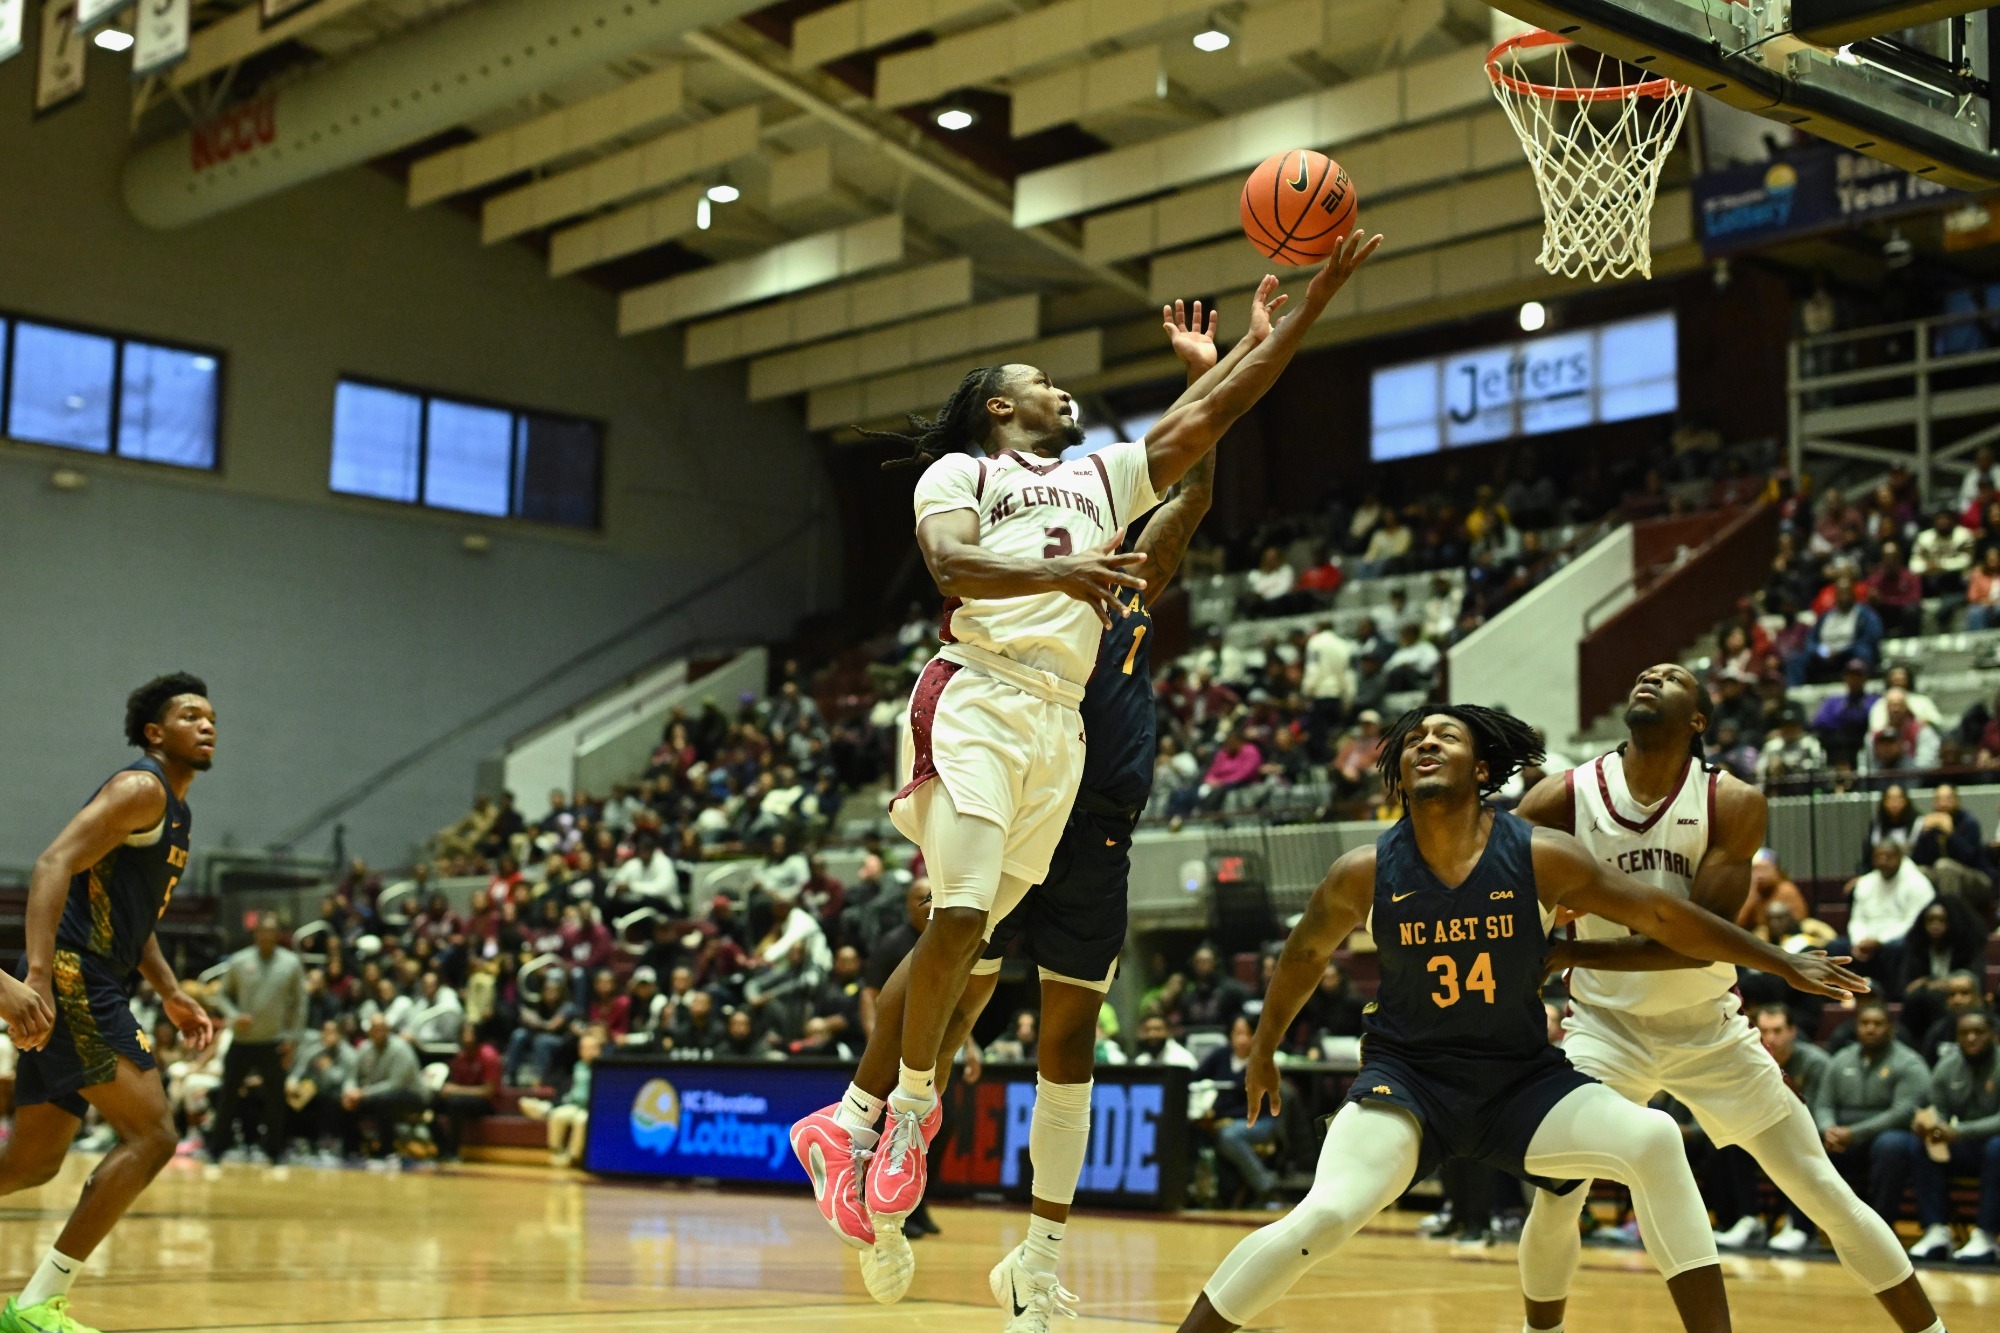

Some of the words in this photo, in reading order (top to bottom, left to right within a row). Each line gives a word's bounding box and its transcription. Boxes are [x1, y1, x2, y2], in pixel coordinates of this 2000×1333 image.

[1321, 167, 1349, 215] ELITE
[1450, 351, 1587, 424] Jeffers
[990, 493, 1016, 527] NC
[1022, 485, 1103, 532] CENTRAL
[1122, 625, 1147, 676] 1
[1677, 818, 1699, 826] MEAC
[1617, 848, 1692, 879] CENTRAL
[1489, 890, 1514, 900] CAA
[1399, 921, 1427, 946] NC
[1433, 917, 1478, 944] A&T
[1486, 914, 1514, 940] SU
[1426, 952, 1496, 1009] 34
[677, 1112, 791, 1169] Lottery
